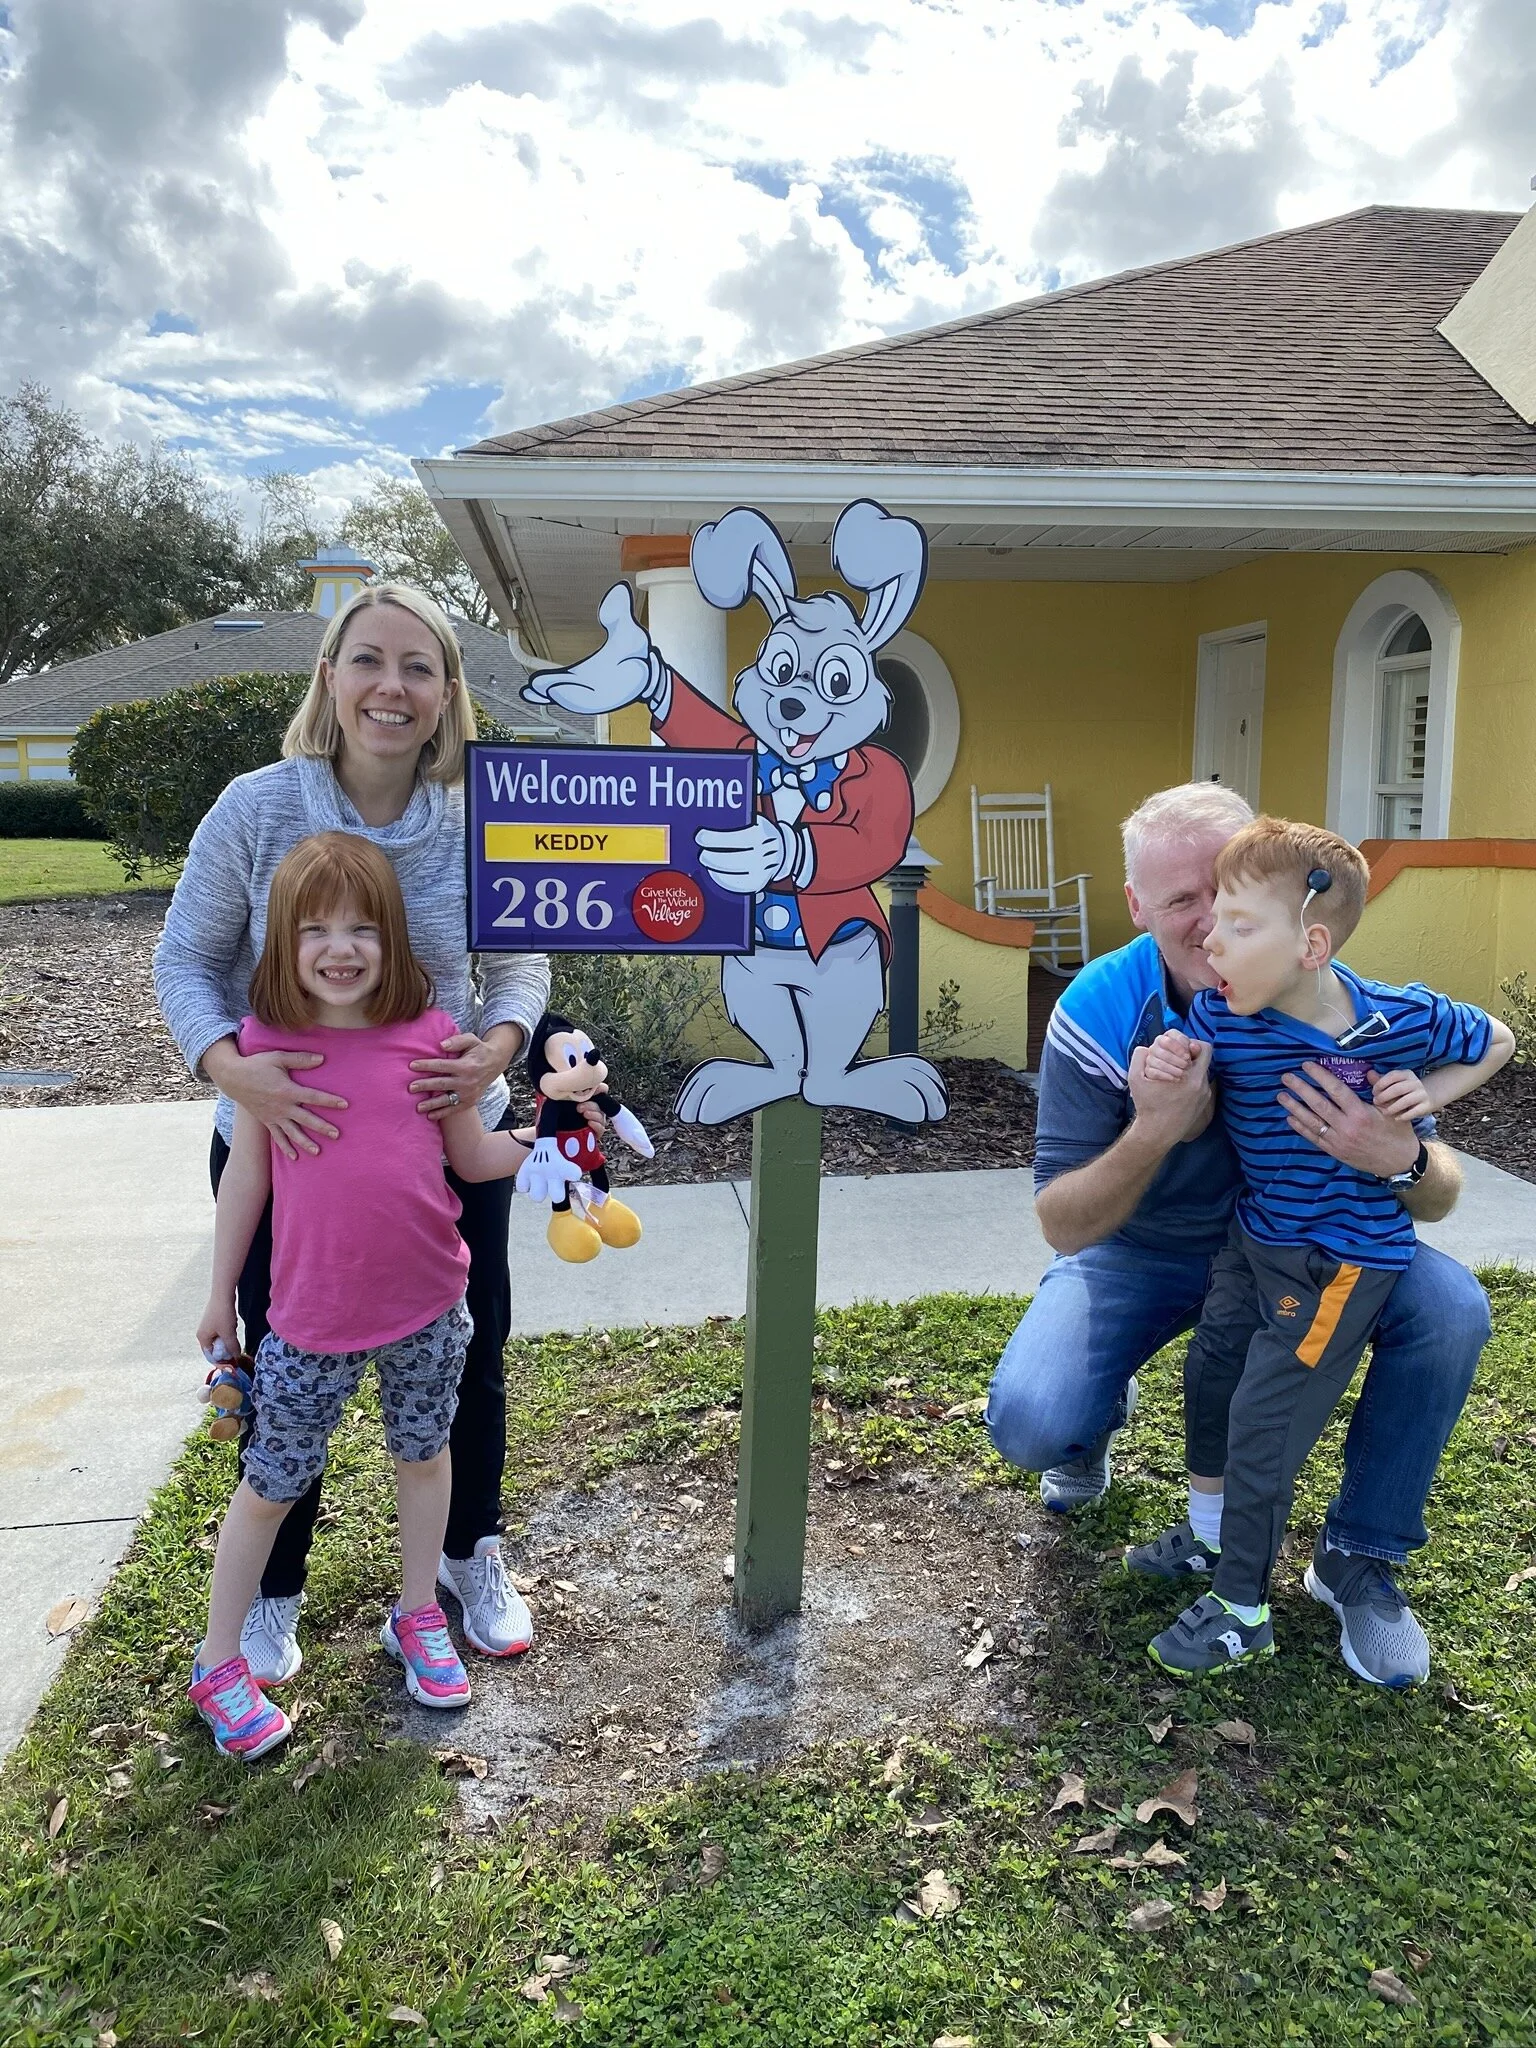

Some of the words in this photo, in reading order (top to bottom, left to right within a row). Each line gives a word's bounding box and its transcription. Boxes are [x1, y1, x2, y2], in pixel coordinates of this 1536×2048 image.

[485, 759, 637, 806] Welcome
[649, 766, 743, 809] Home
[535, 834, 608, 851] KEDDY
[491, 877, 613, 930] 286
[641, 887, 665, 898] Give
[665, 887, 687, 898] Kids
[667, 897, 698, 907] World
[641, 899, 691, 926] Village
